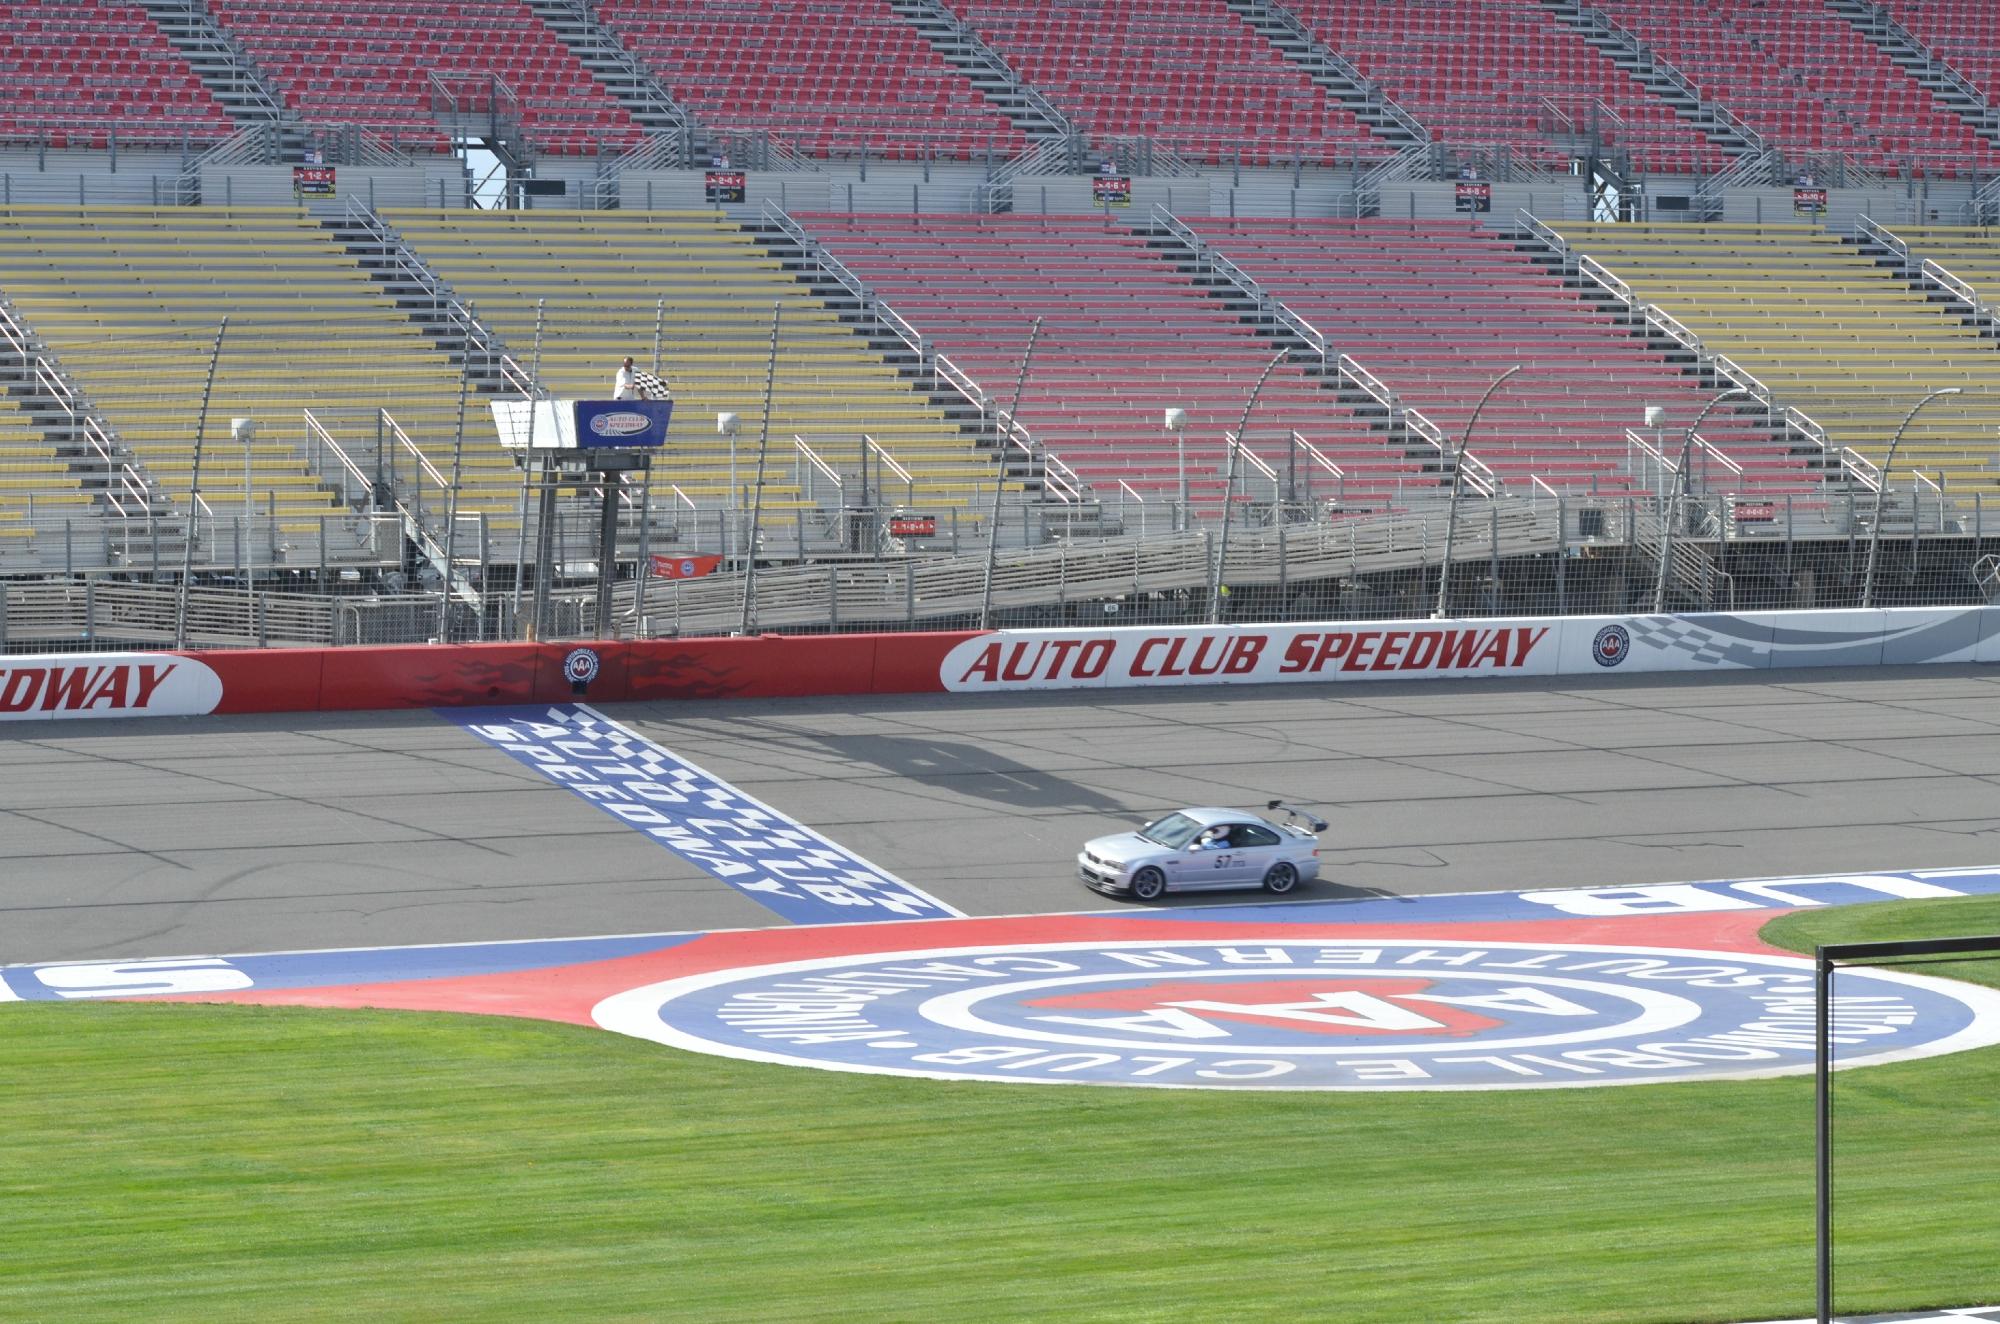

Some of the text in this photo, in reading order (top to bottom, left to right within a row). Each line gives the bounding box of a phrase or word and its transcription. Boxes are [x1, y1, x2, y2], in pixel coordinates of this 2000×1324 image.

[573, 659, 590, 671] AAA
[958, 626, 1552, 683] AUTO CLUB SPEEDWAY
[1602, 638, 1620, 650] AAA
[0, 663, 178, 712] DWAY
[467, 723, 807, 901] SPEEDWAY
[509, 717, 875, 908] AUTO CLUB
[1214, 855, 1232, 868] 57
[1102, 943, 1814, 988] SOUTHERN
[716, 956, 1082, 1044] CALIFORNIA
[1023, 986, 1599, 1039] AAA
[911, 1044, 1297, 1080] CLUB
